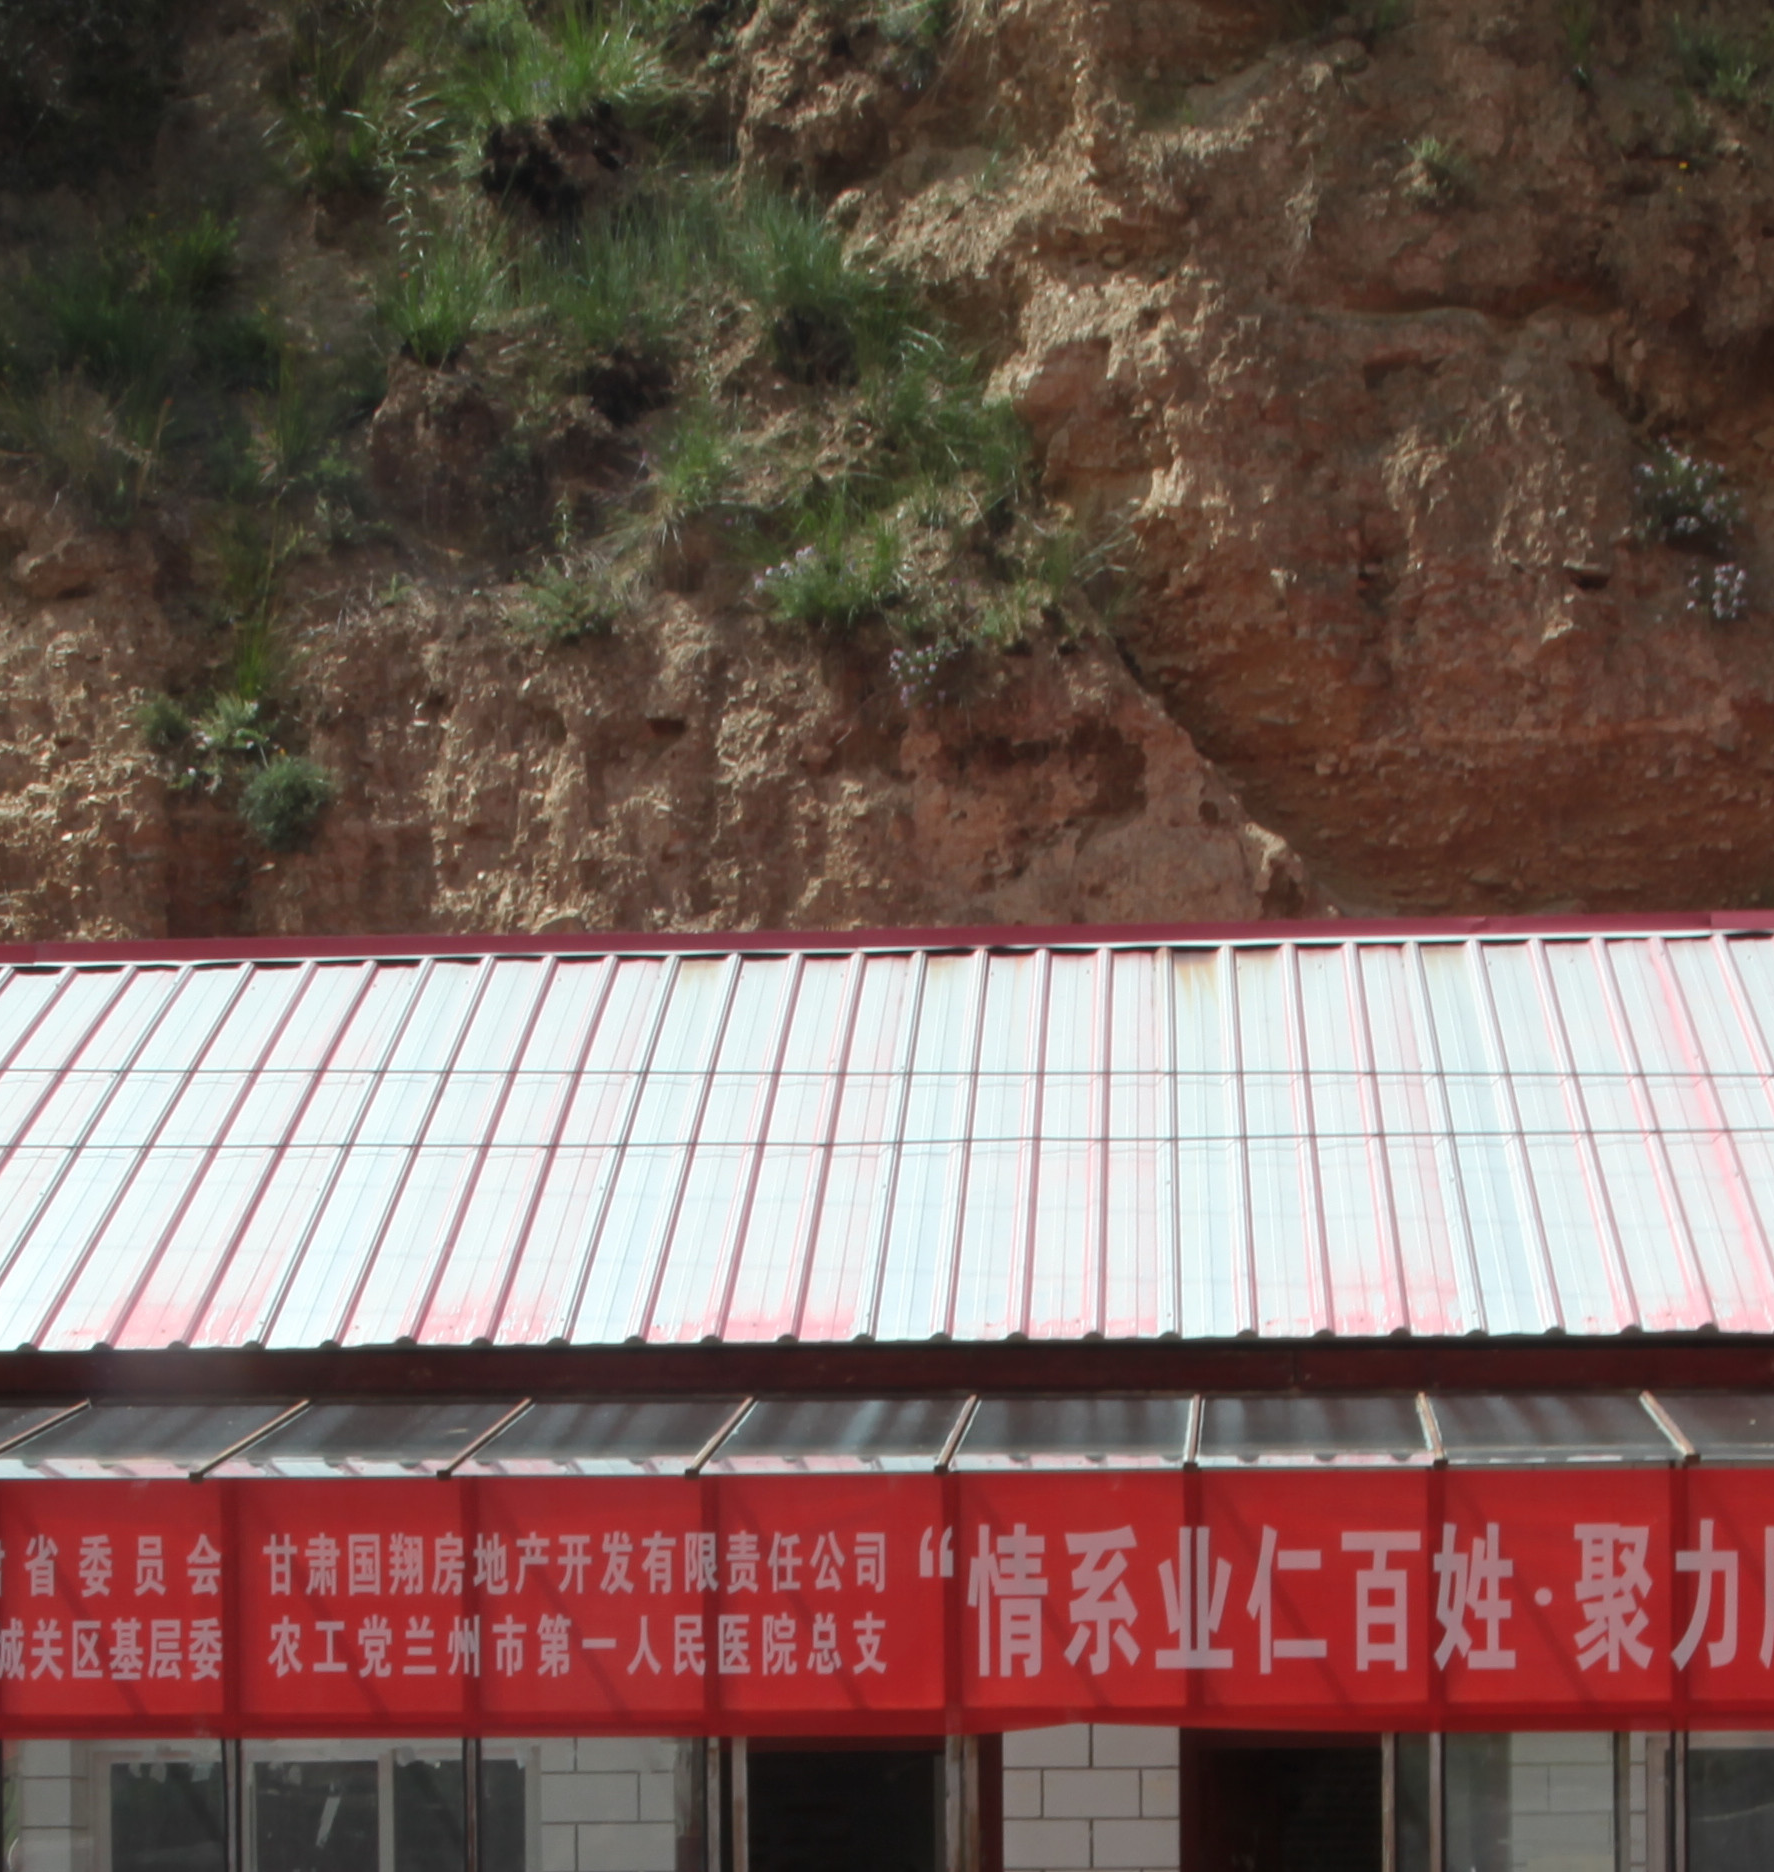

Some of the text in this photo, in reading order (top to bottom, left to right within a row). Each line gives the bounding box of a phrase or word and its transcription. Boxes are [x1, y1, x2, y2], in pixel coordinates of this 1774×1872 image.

[263, 1531, 885, 1595] 甘肃国翔房地产开发有限责任公司
[268, 1612, 887, 1677] 农工党兰州市第一人民医院总支
